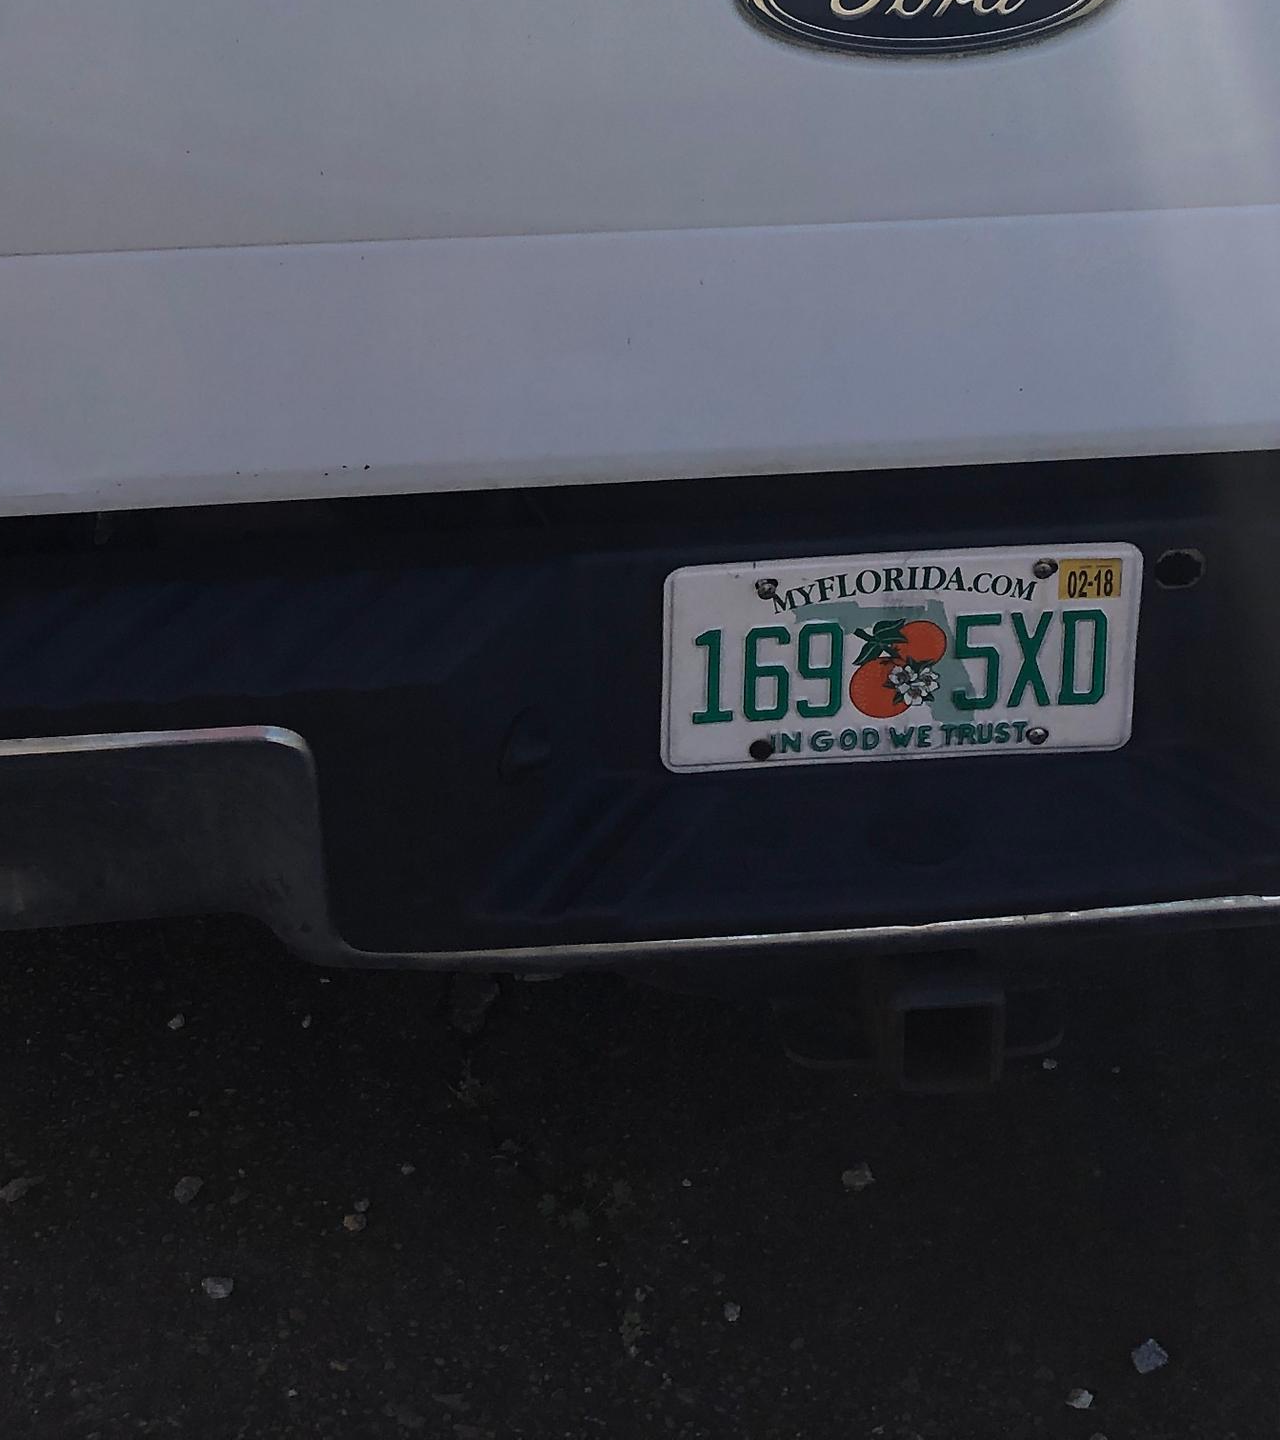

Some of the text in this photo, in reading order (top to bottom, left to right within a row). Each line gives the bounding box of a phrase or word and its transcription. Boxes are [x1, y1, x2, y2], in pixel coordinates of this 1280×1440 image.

[771, 566, 1037, 614] MYFLORIDA.COM
[1067, 569, 1114, 598] 02-18
[692, 609, 1108, 725] 169 5XD
[810, 727, 881, 753] GOD
[888, 723, 932, 749] WE
[941, 720, 1029, 745] TRUST
